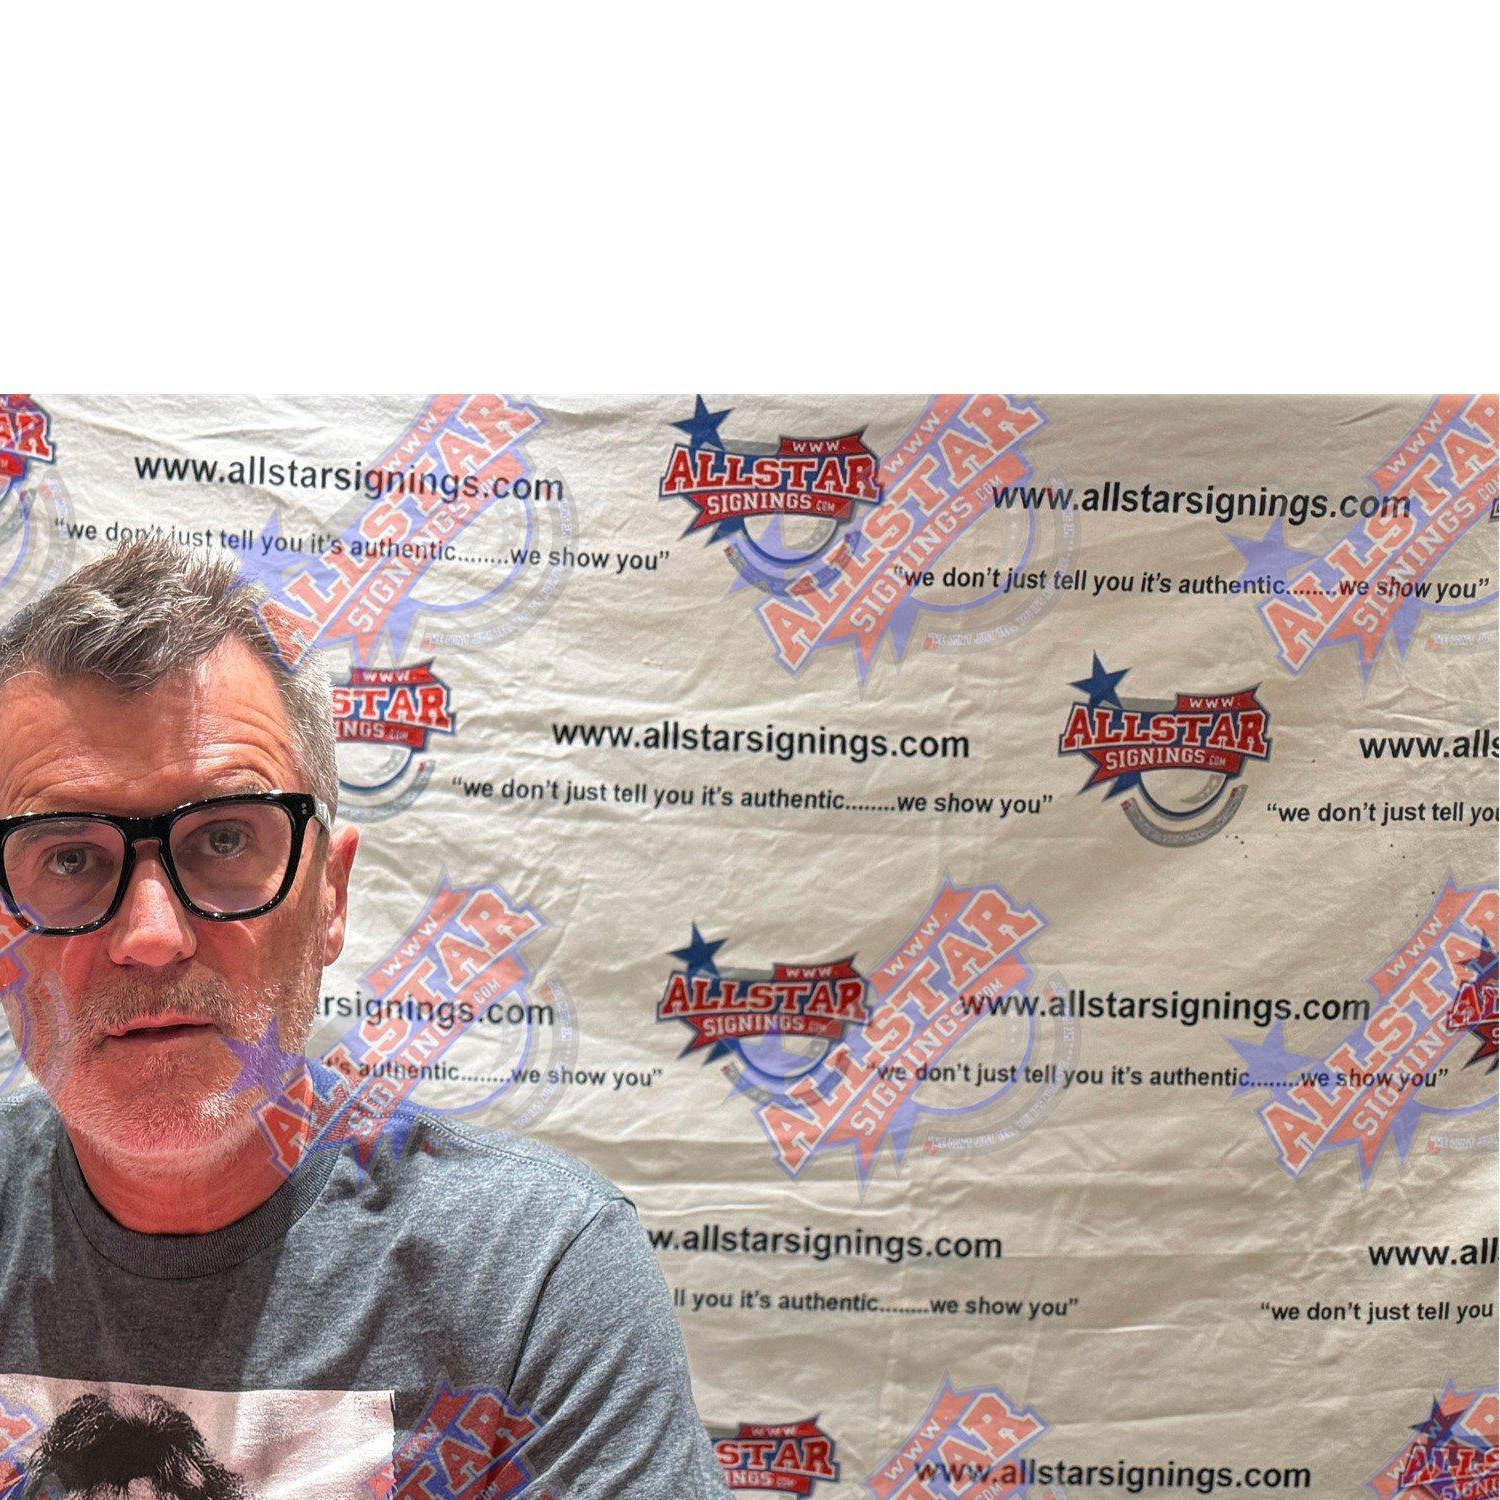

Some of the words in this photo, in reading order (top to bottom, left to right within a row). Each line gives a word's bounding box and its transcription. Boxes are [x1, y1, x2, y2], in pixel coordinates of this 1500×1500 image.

[134, 456, 563, 501] www.allstarsignings.com
[661, 450, 882, 500] ALLSTAR
[706, 490, 812, 514] SIGNINGS
[992, 483, 1411, 524] www.allstarsignings.com
[552, 721, 969, 763] www.allstarsignings.com
[1060, 704, 1270, 759] ALLSTAR
[1104, 748, 1206, 771] SIGNINGS
[565, 781, 606, 804] just
[614, 784, 647, 803] tell
[654, 789, 694, 809] you
[934, 793, 993, 813] show
[660, 976, 871, 1023] ALLSTAR
[960, 988, 1370, 1027] www.allstarsignings.com
[702, 1014, 806, 1037] SIGNINGS
[1367, 1302, 1410, 1325] just
[1417, 1302, 1450, 1320] tell
[1456, 1303, 1493, 1324] you
[914, 1459, 1311, 1494] www.allstarsignings.com
